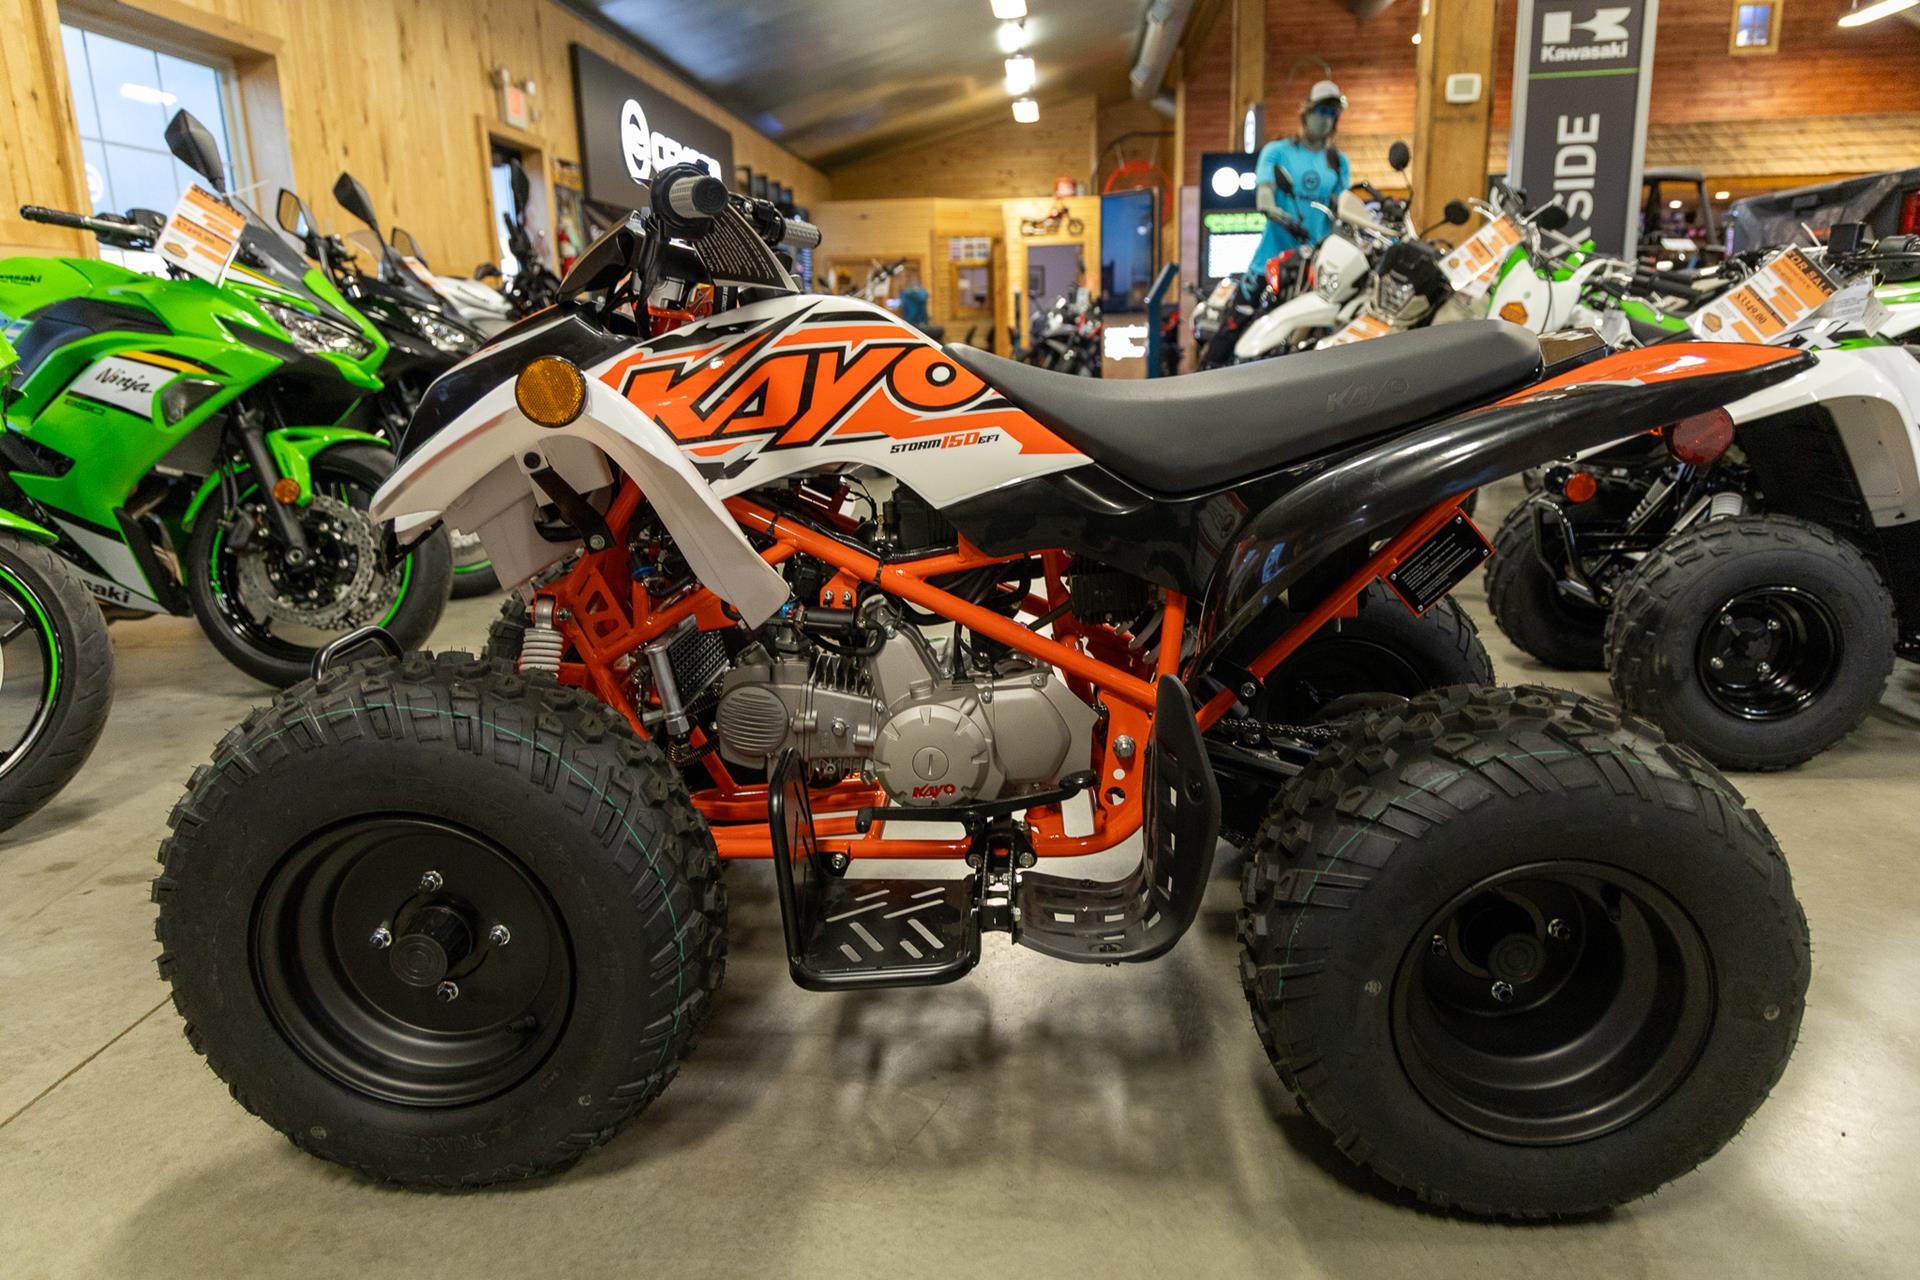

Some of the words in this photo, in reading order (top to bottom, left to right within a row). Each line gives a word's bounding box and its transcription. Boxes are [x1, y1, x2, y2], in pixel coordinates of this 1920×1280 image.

[1541, 41, 1628, 63] Kawasaki
[1553, 113, 1600, 221] SIDE
[94, 367, 152, 393] Ninja
[622, 335, 992, 450] KAYO
[912, 783, 956, 799] KAYO
